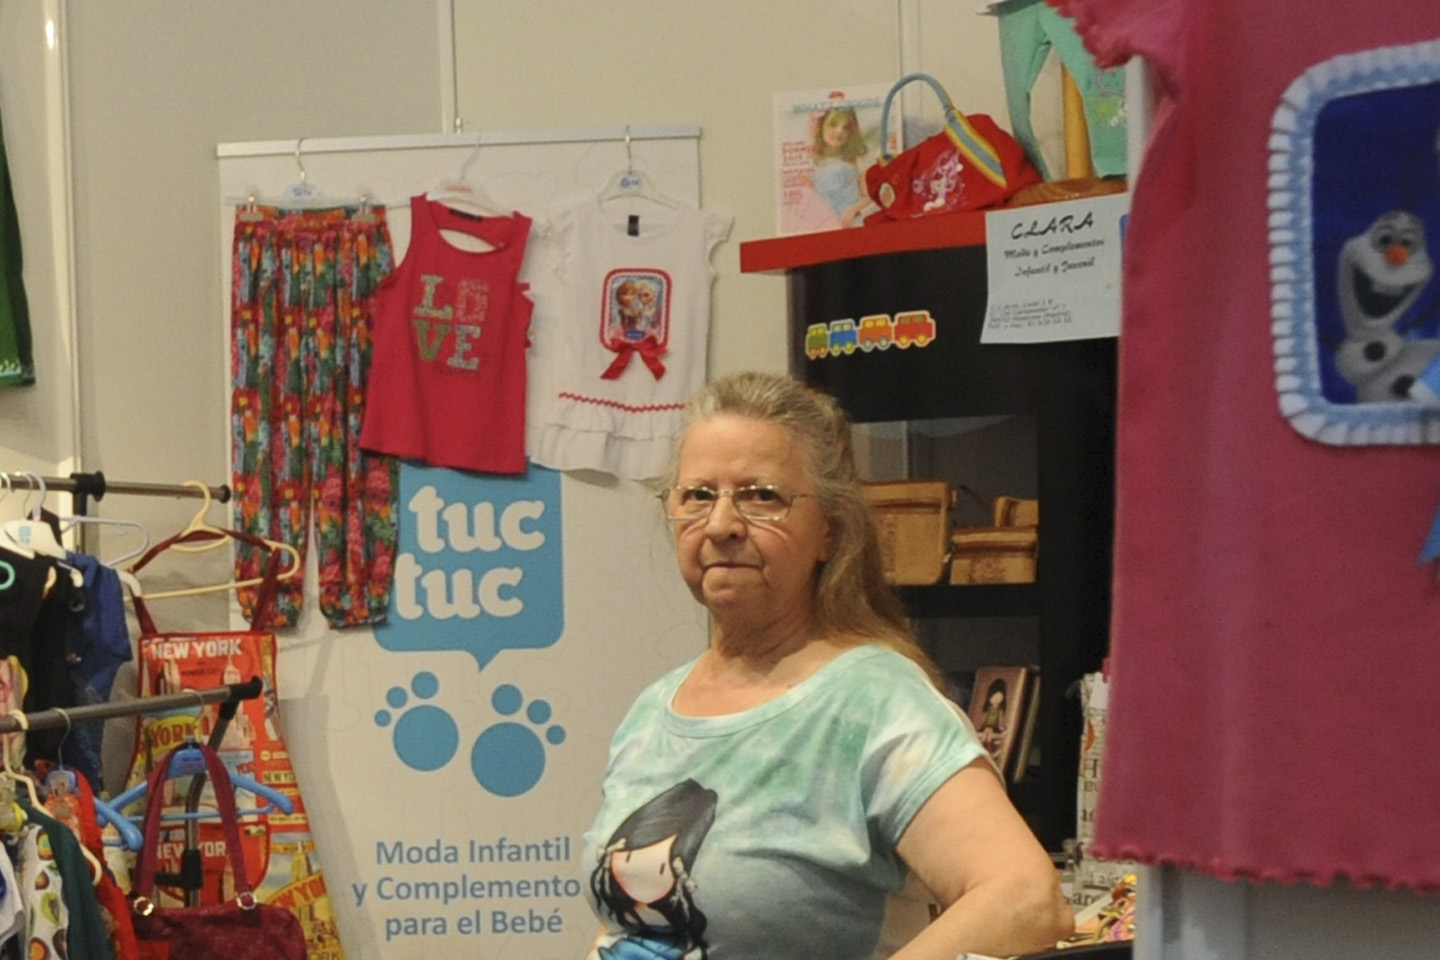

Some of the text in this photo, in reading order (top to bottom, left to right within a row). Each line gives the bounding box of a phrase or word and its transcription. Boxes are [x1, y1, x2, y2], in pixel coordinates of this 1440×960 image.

[1011, 211, 1094, 240] CLARA
[1041, 239, 1105, 255] Complementos
[408, 485, 545, 553] tuc
[394, 552, 524, 620] tuc
[152, 638, 242, 659] NEW YORK
[376, 836, 570, 864] Moda Infantil
[352, 882, 368, 907] y
[386, 907, 564, 942] para el Bebé
